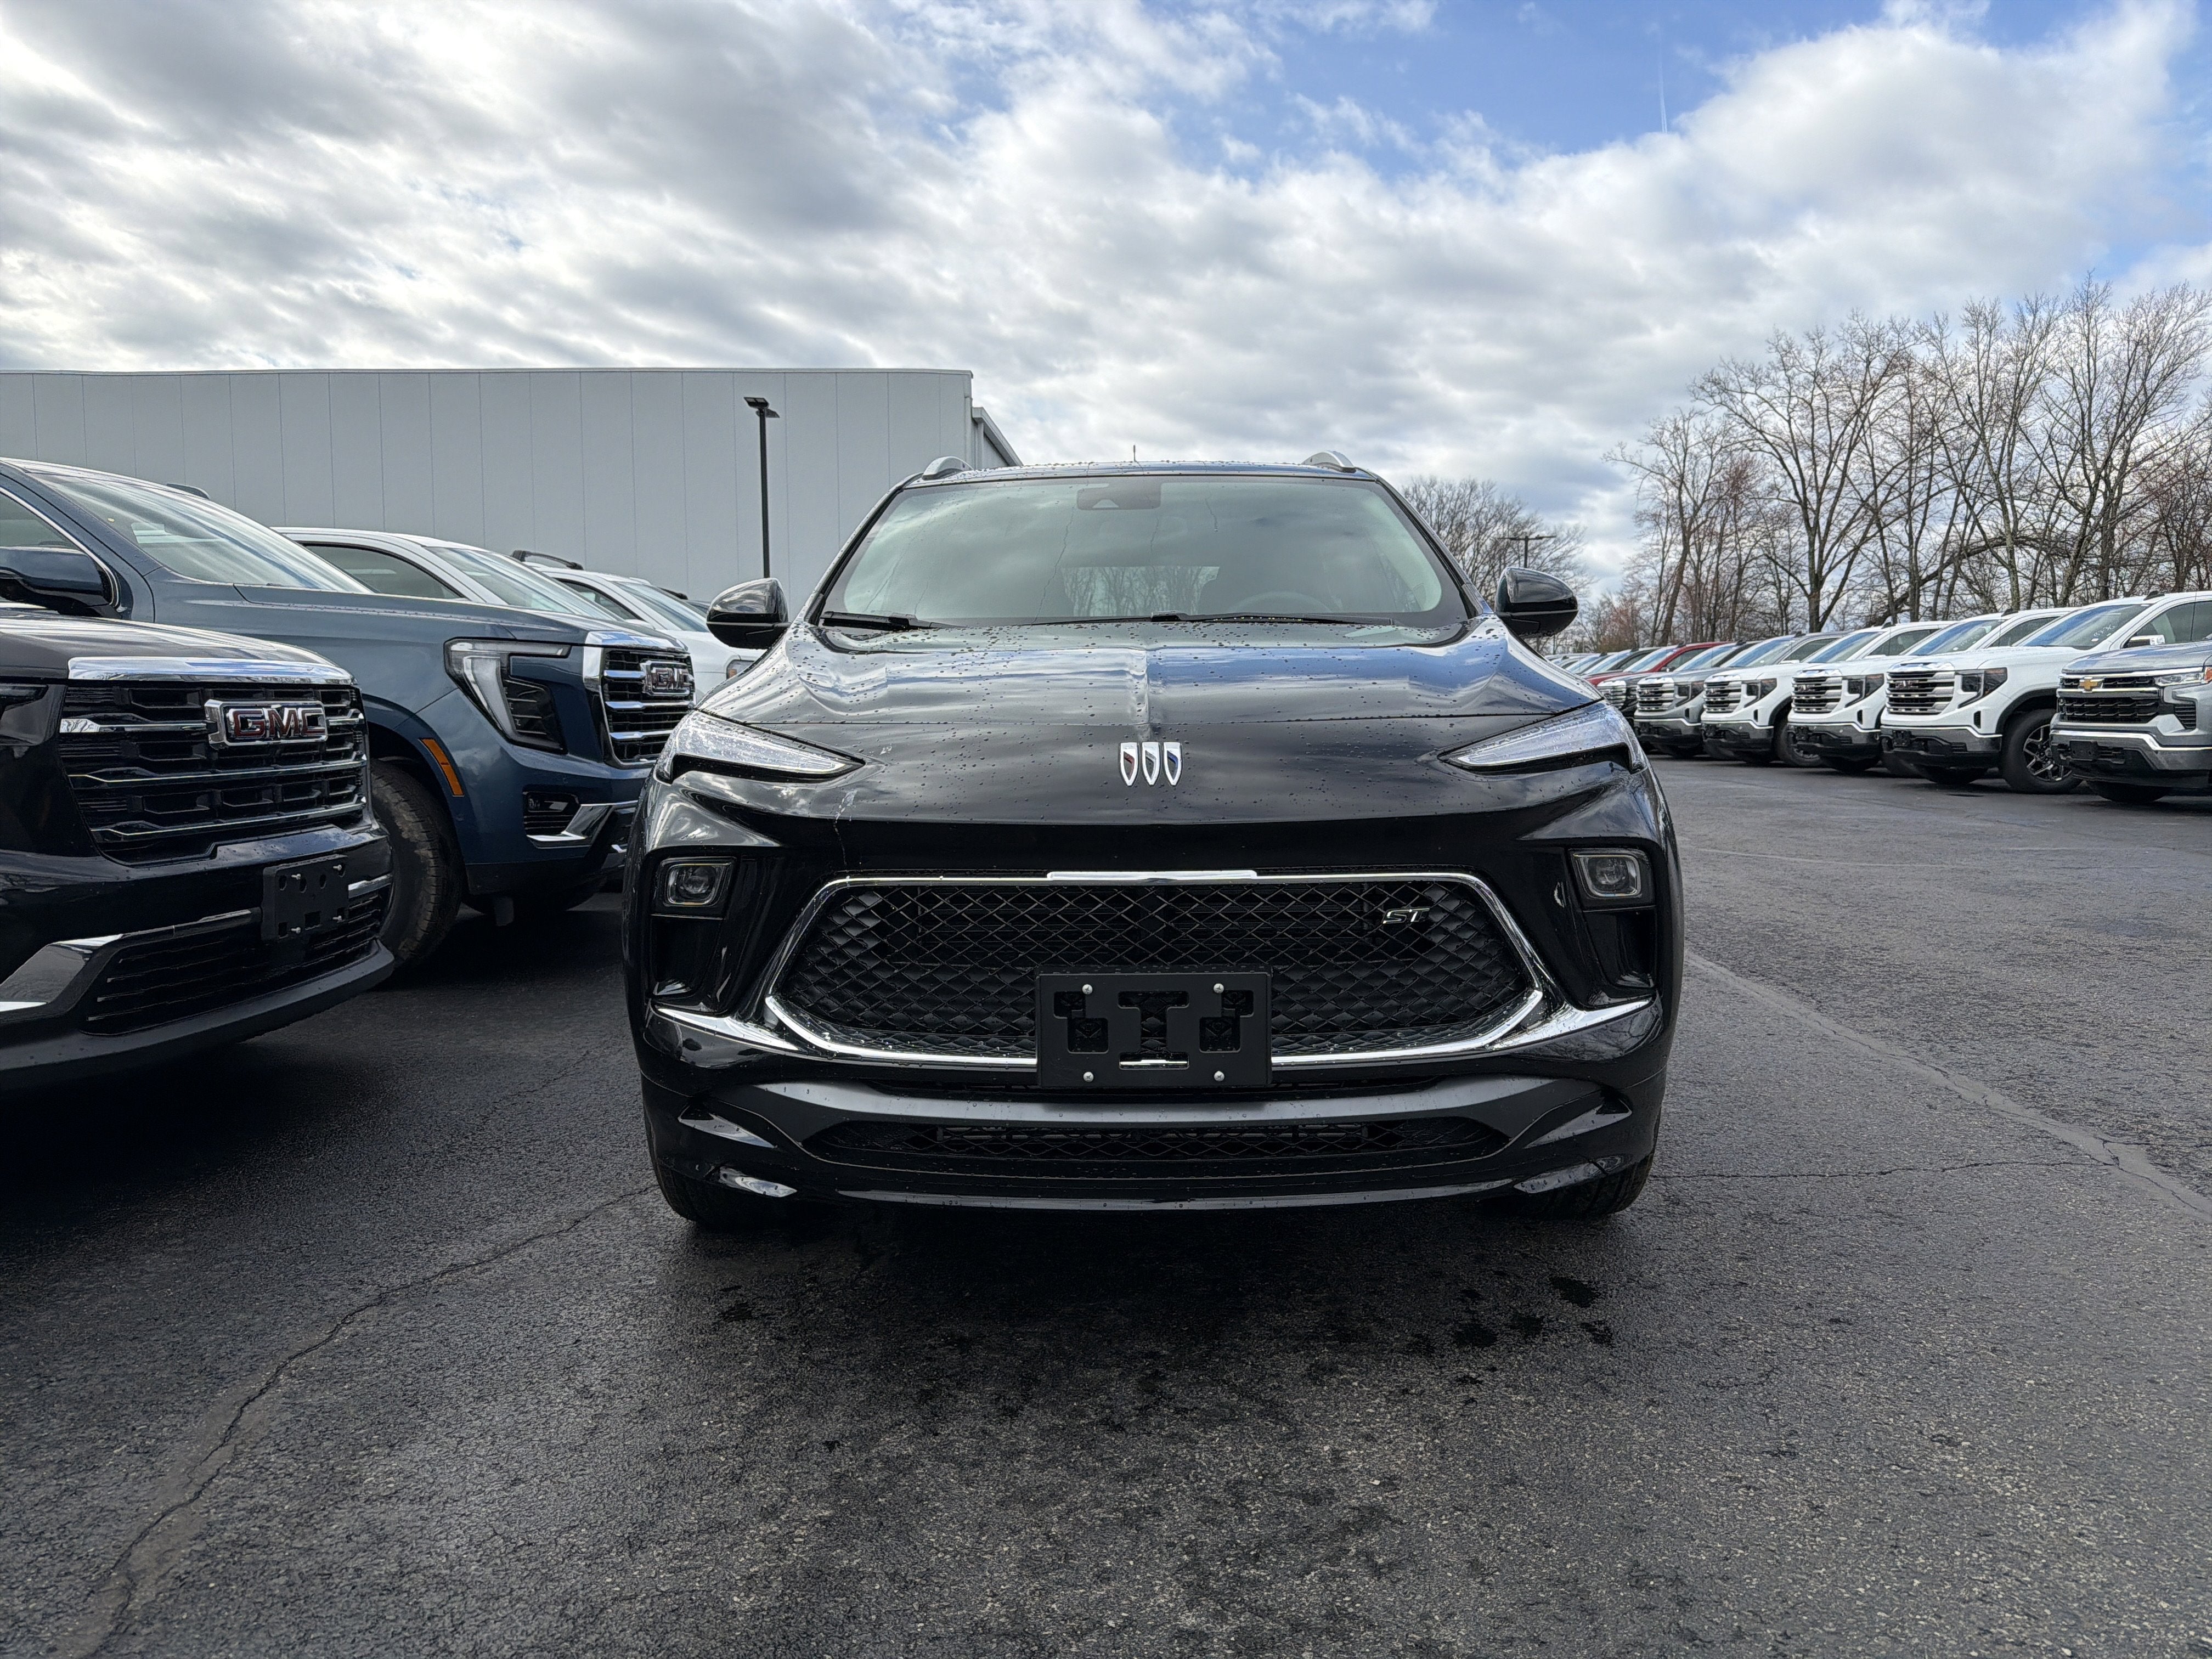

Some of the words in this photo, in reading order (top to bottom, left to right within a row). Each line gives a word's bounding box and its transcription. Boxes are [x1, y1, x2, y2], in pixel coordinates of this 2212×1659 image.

[651, 667, 694, 690] GMC
[225, 707, 326, 740] GMC
[1381, 906, 1431, 924] ST
